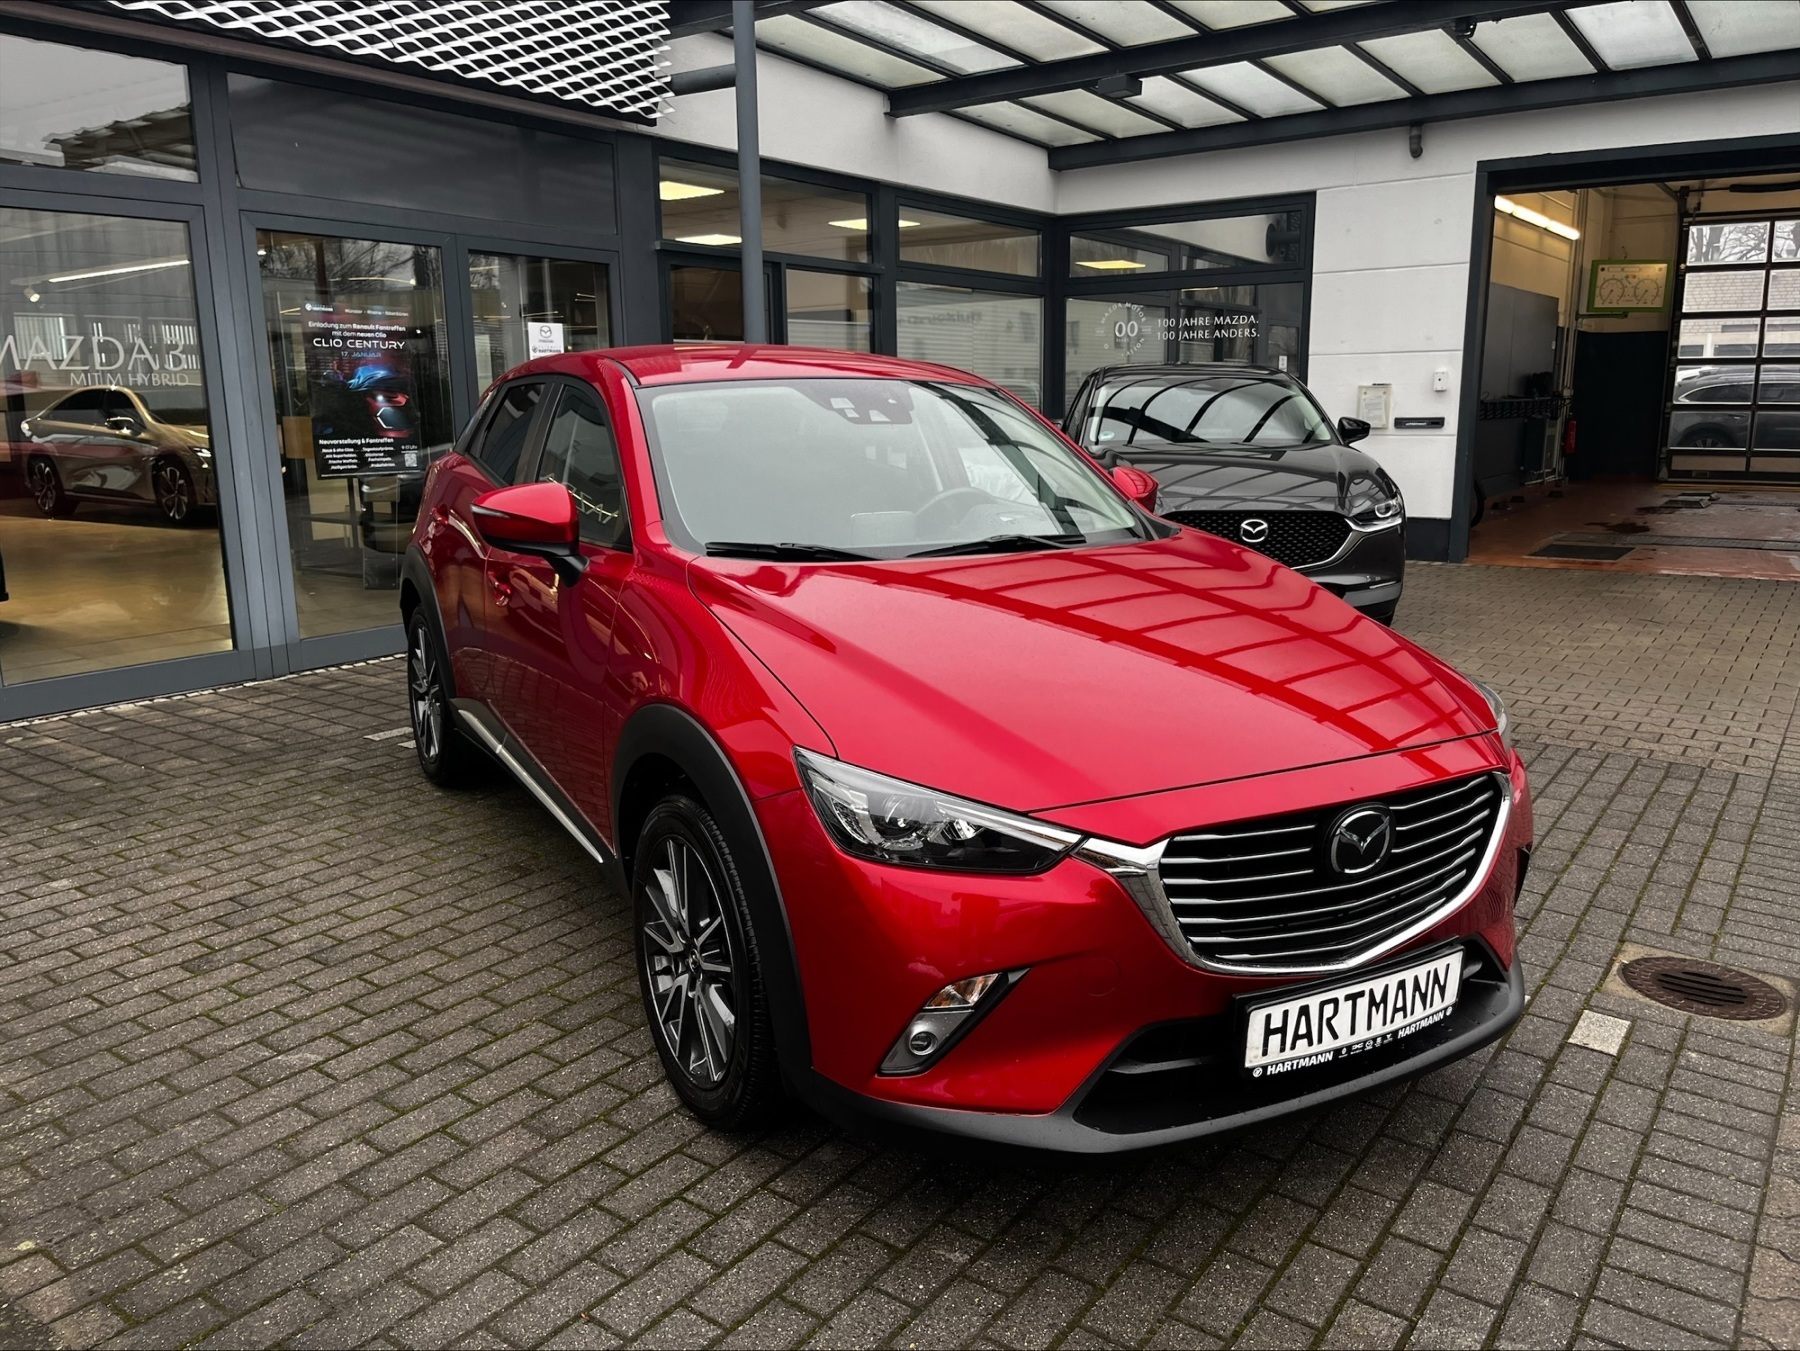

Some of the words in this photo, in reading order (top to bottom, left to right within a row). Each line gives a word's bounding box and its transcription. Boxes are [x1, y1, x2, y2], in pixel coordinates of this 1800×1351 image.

[308, 321, 339, 330] Einladung
[376, 324, 407, 332] Fantreffen
[1157, 318, 1176, 328] 100
[1178, 316, 1210, 328] JAHRE
[1213, 315, 1259, 326] MAZDA.
[376, 331, 387, 339] Clio
[1157, 331, 1176, 341] 100
[1178, 329, 1210, 342] JAHRE
[1213, 328, 1260, 339] ANDERS.
[313, 338, 343, 348] CLIO
[347, 339, 405, 350] CENTURY
[70, 372, 103, 386] MIT
[106, 373, 123, 386] M
[129, 373, 189, 386] HYBRID
[1261, 963, 1451, 1057] HARTMANN
[1266, 1050, 1333, 1075] HARTMANN
[1397, 1010, 1444, 1039] HARTMANN
